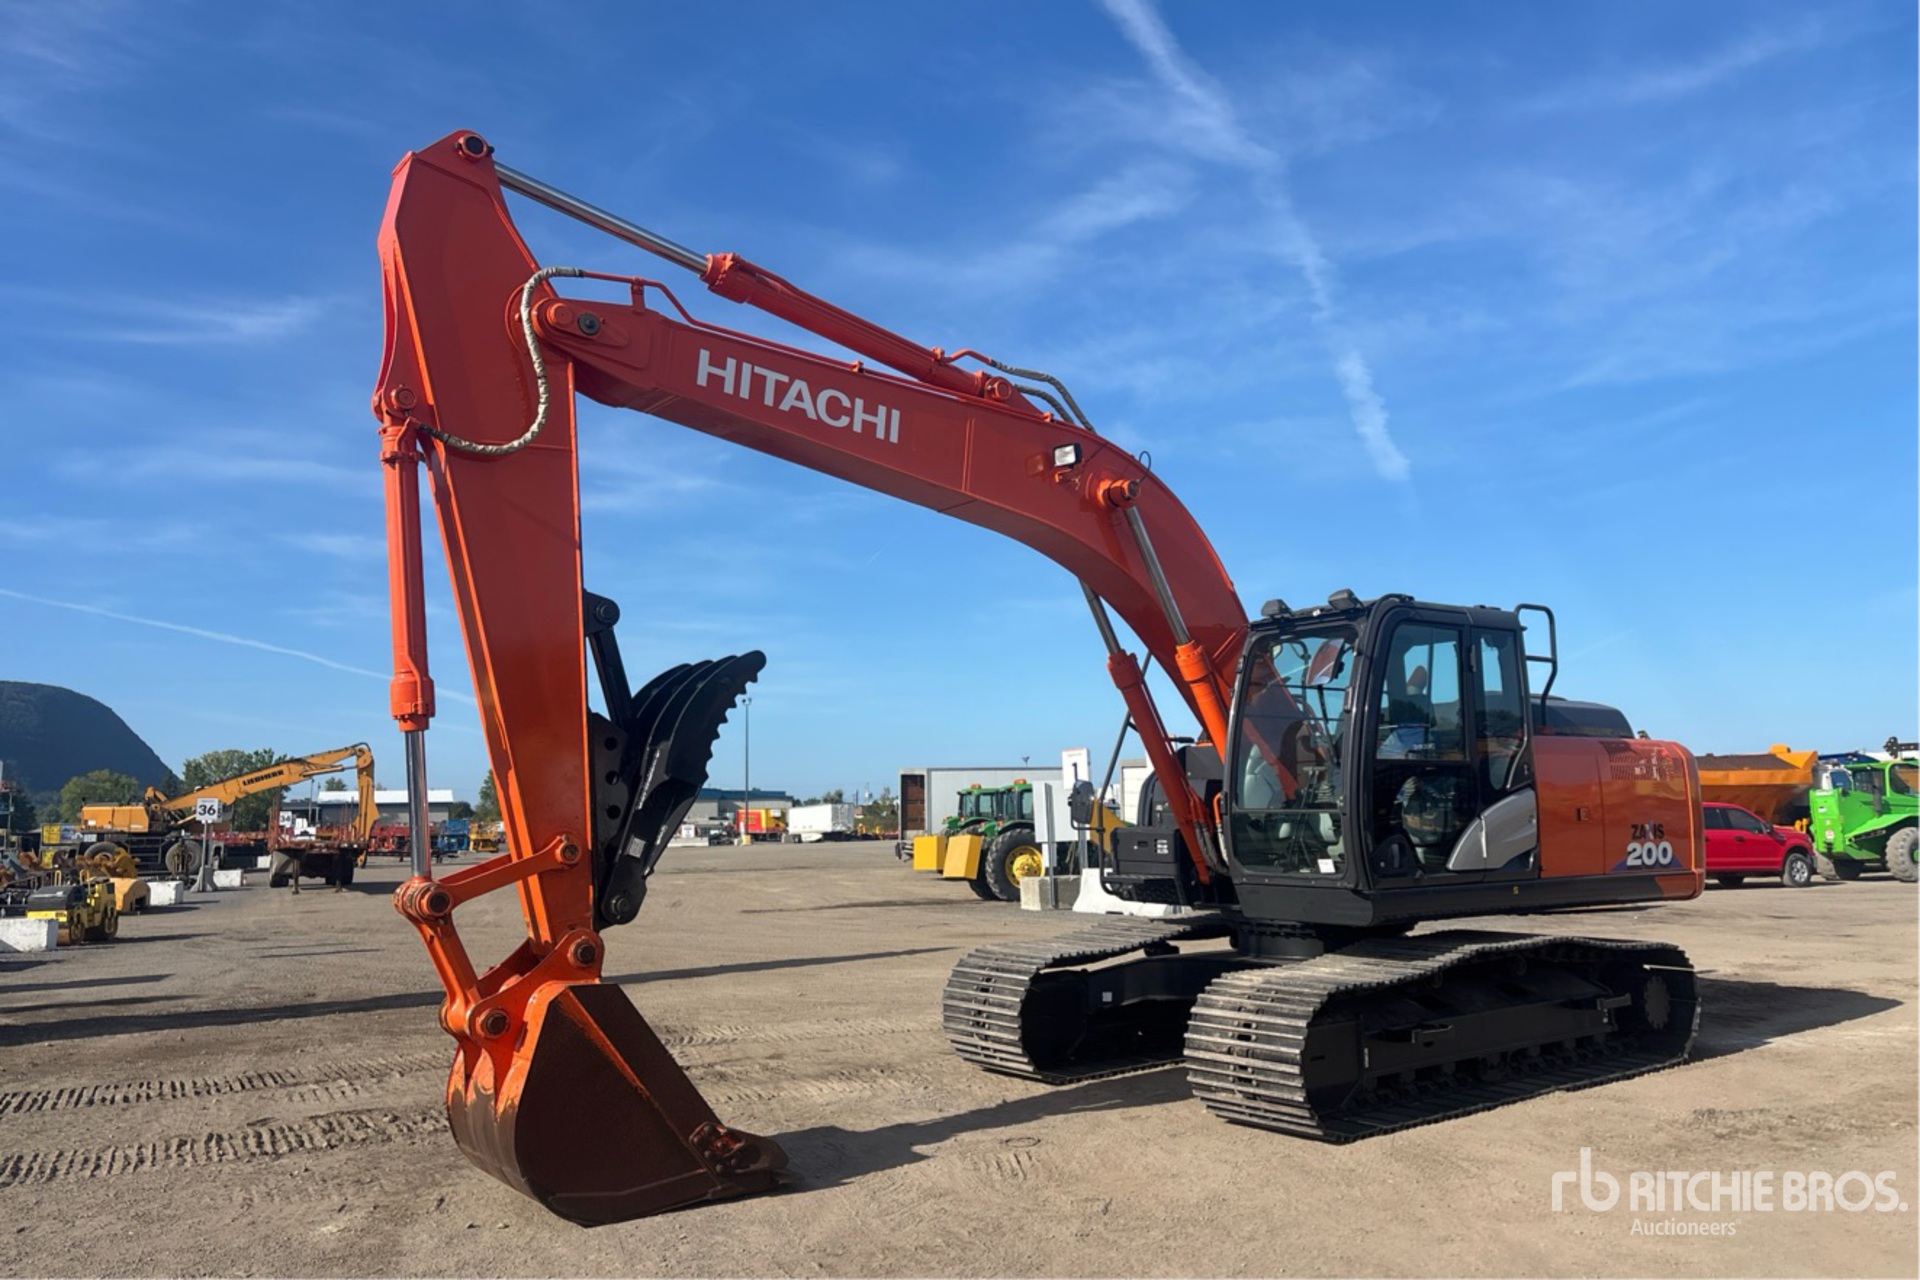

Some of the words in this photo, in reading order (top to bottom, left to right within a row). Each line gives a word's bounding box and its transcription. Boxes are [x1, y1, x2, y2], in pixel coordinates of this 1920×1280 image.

[696, 348, 901, 444] HITACHI
[198, 804, 216, 816] 36
[1626, 841, 1673, 866] 200
